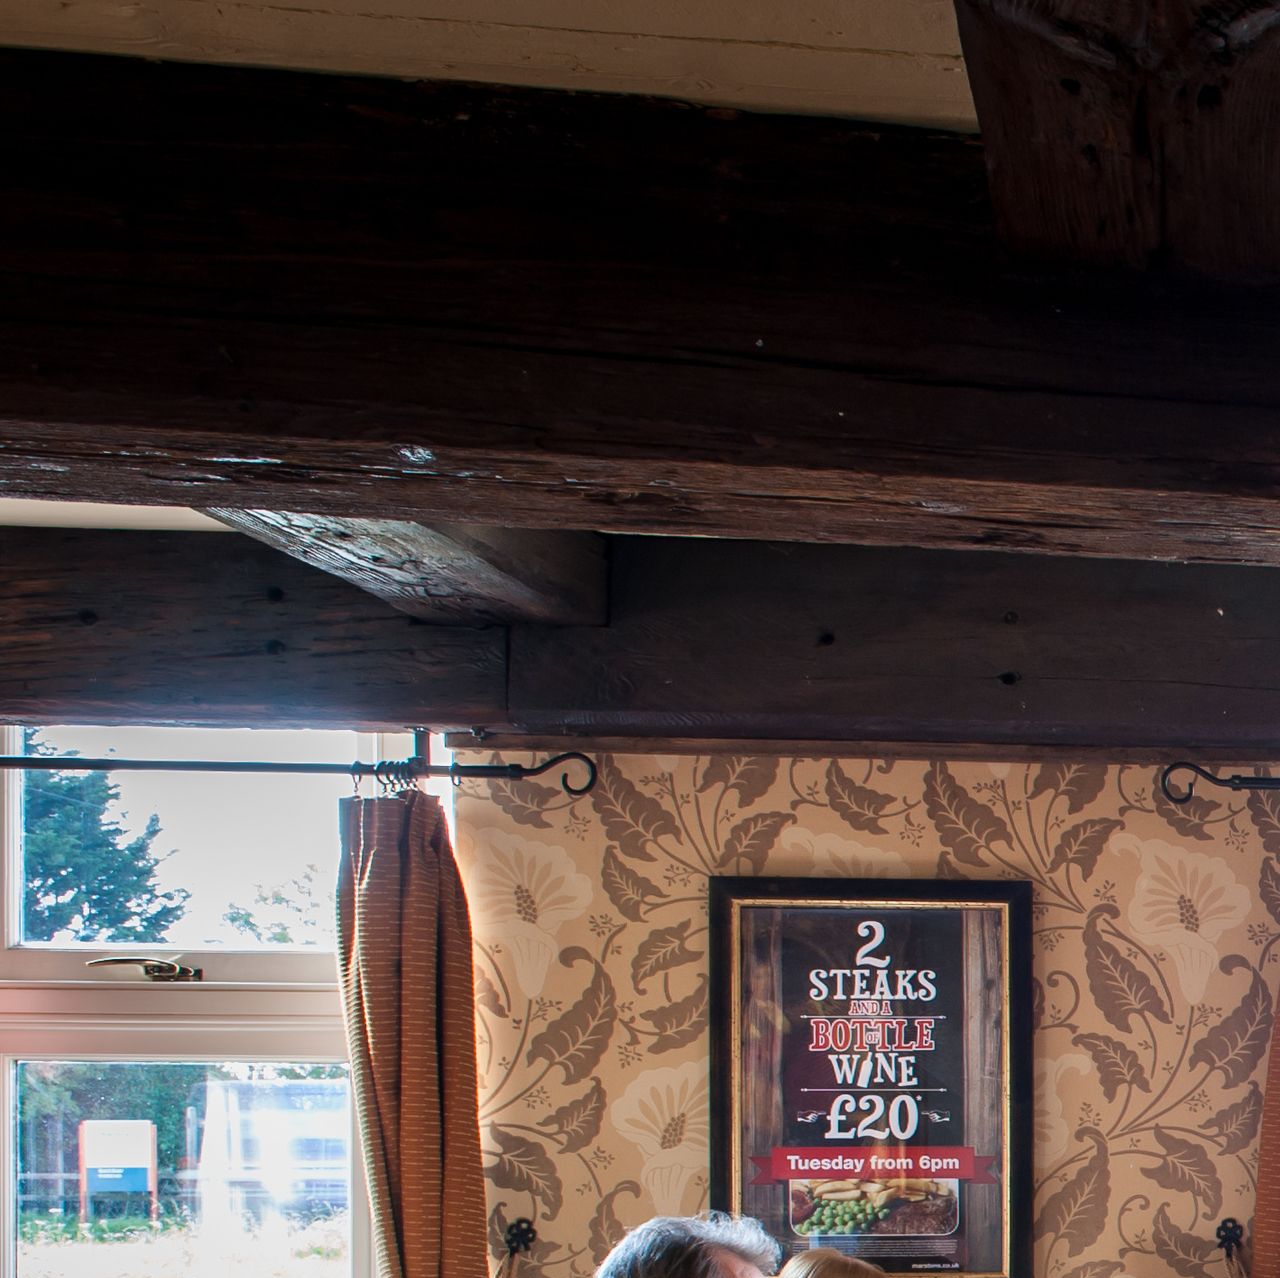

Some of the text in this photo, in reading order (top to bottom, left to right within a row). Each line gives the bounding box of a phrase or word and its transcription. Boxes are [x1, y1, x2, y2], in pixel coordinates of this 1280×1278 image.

[856, 920, 891, 968] 2
[809, 969, 937, 1001] STEAKS
[848, 1000, 893, 1015] AND A
[809, 1018, 936, 1051] BOTTLE
[866, 1031, 880, 1044] OF
[828, 1052, 919, 1089] WINE
[787, 1155, 960, 1172] Tuesday from 6pm
